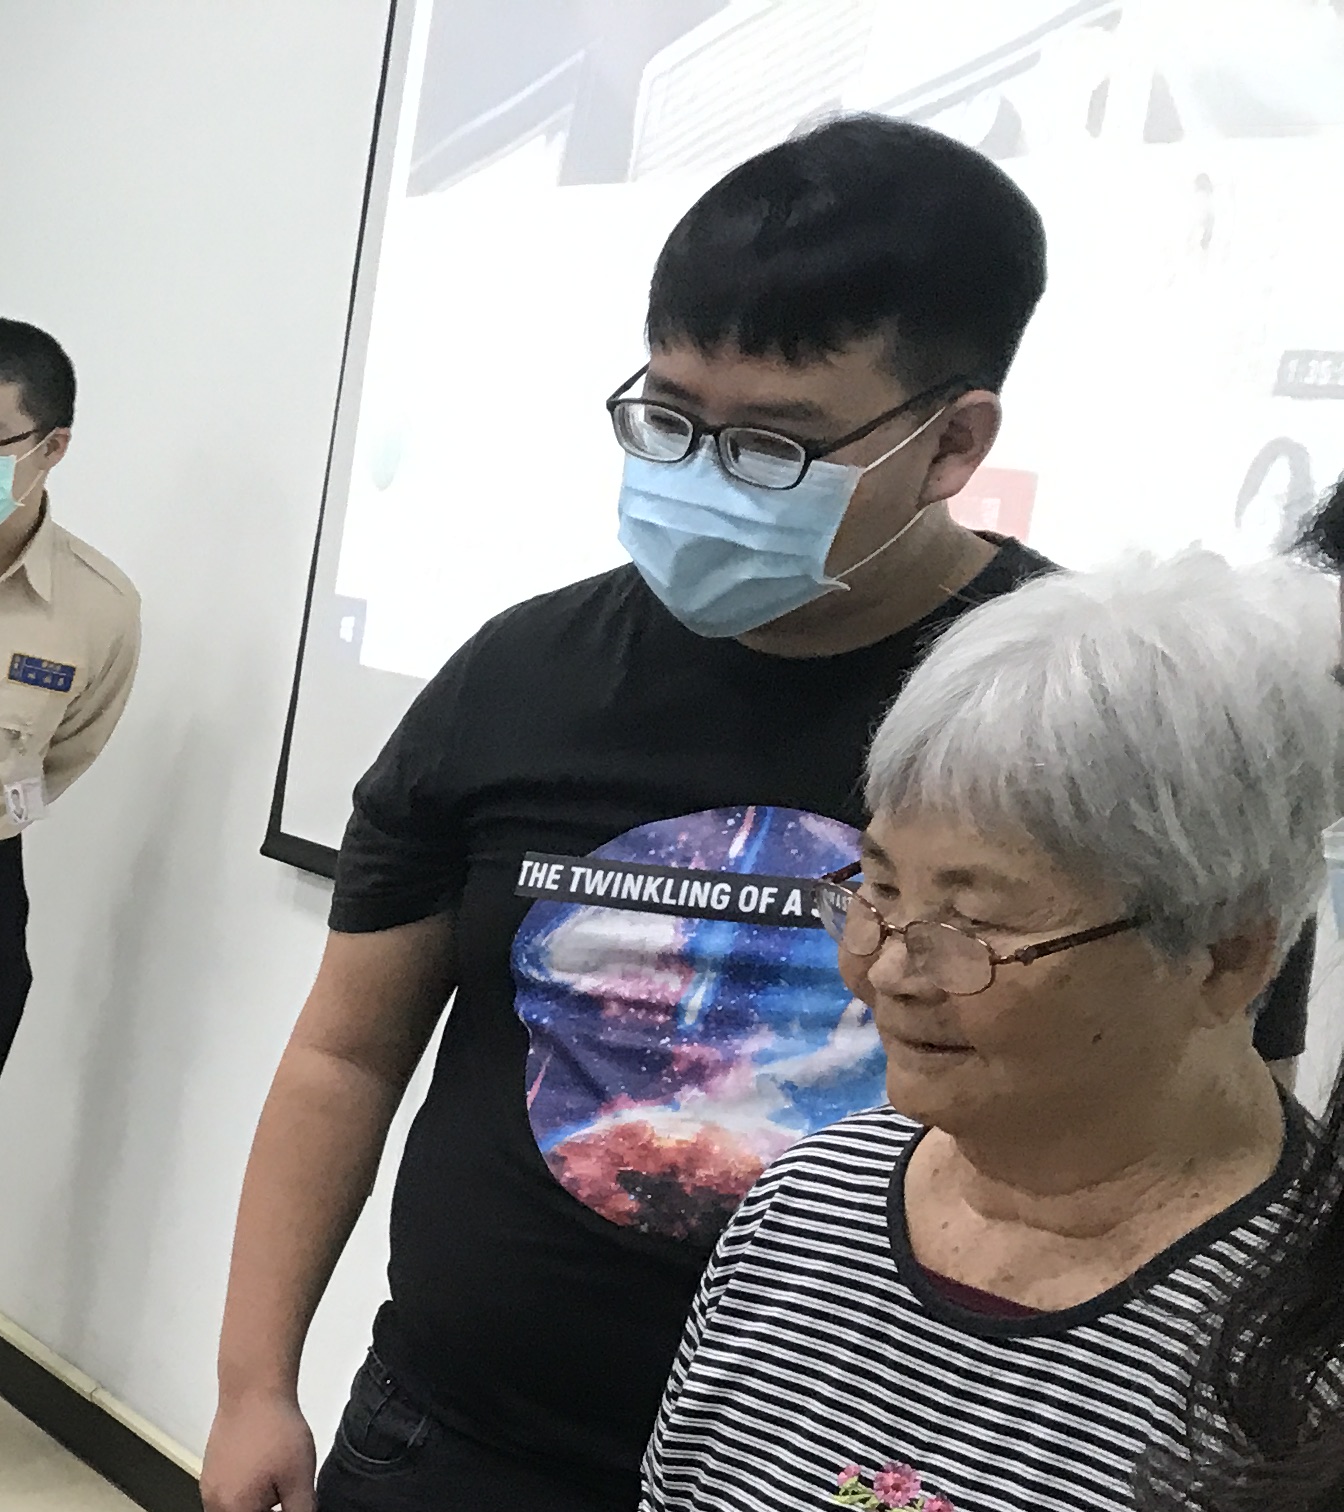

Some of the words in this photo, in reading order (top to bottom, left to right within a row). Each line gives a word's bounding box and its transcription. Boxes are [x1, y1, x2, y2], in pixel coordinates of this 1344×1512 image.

[518, 861, 564, 890] THE
[569, 867, 730, 910] TWINKLING
[738, 885, 778, 914] OF
[782, 889, 802, 917] A
